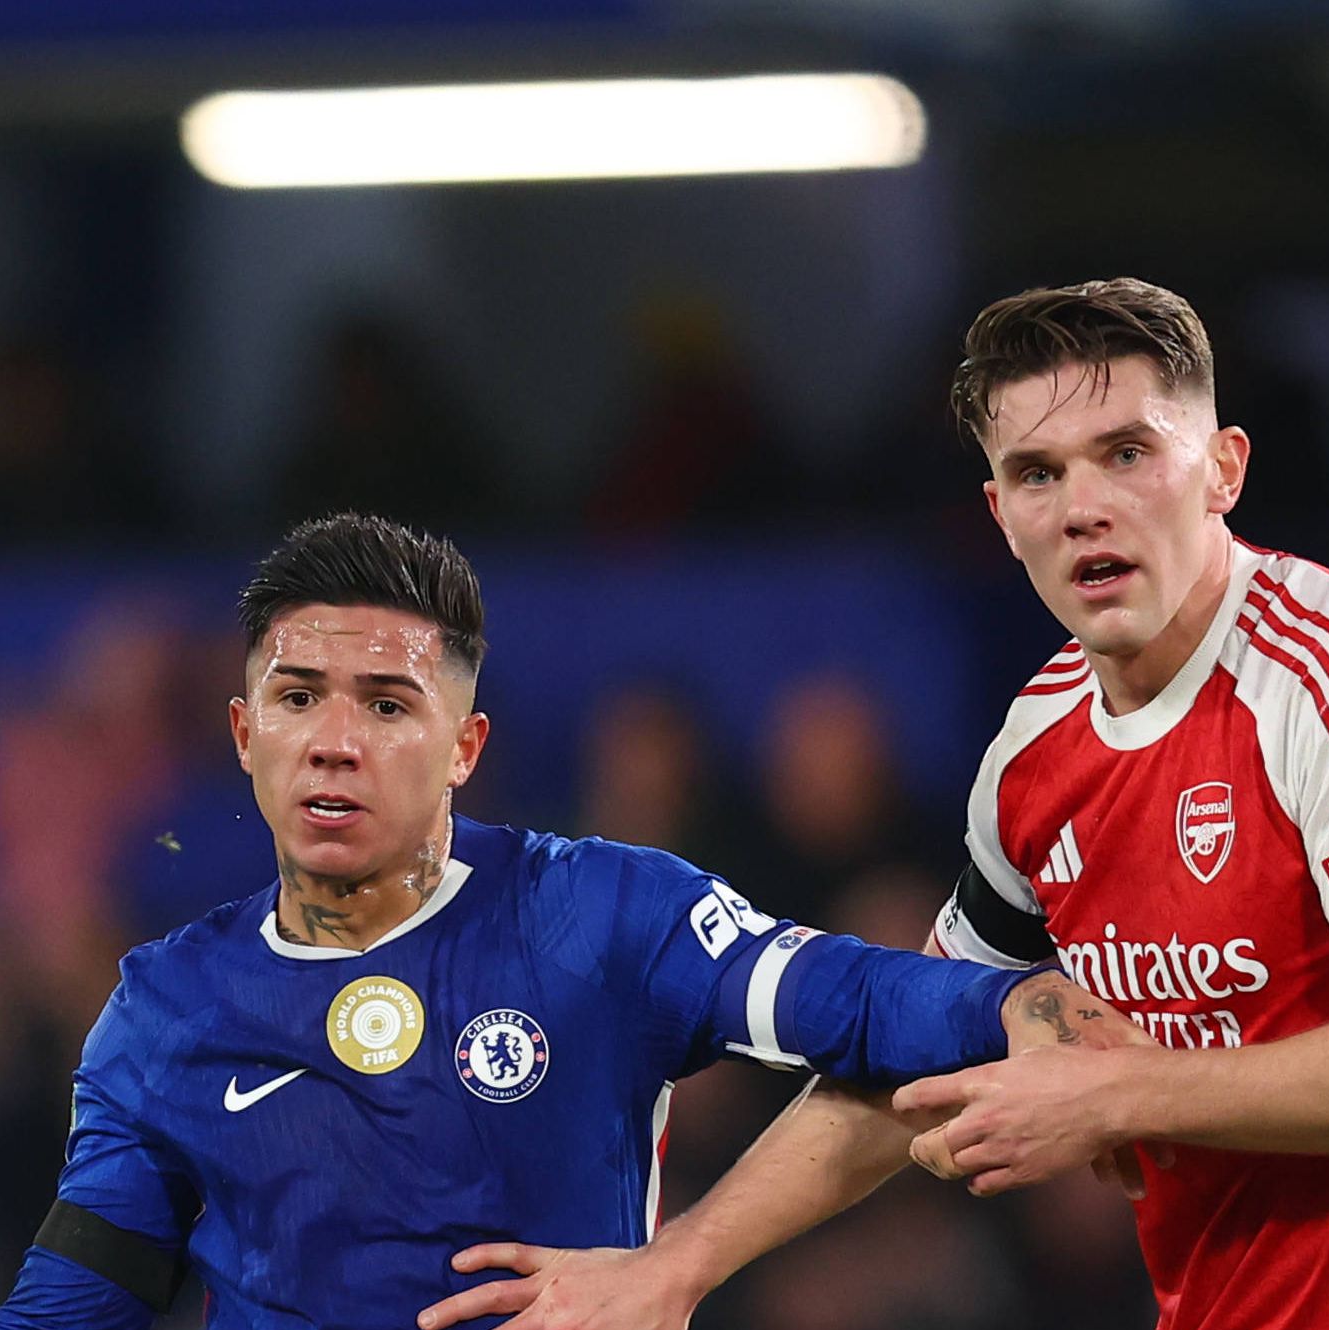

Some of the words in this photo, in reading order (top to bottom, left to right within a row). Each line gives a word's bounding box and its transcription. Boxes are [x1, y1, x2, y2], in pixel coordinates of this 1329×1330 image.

[1188, 798, 1229, 817] Arsenal
[1048, 922, 1269, 1001] mirates
[336, 995, 358, 1042] WORLD
[357, 985, 416, 1029] CHAMPIONS
[466, 1012, 524, 1039] CHELSEA
[361, 1047, 399, 1067] FIFA
